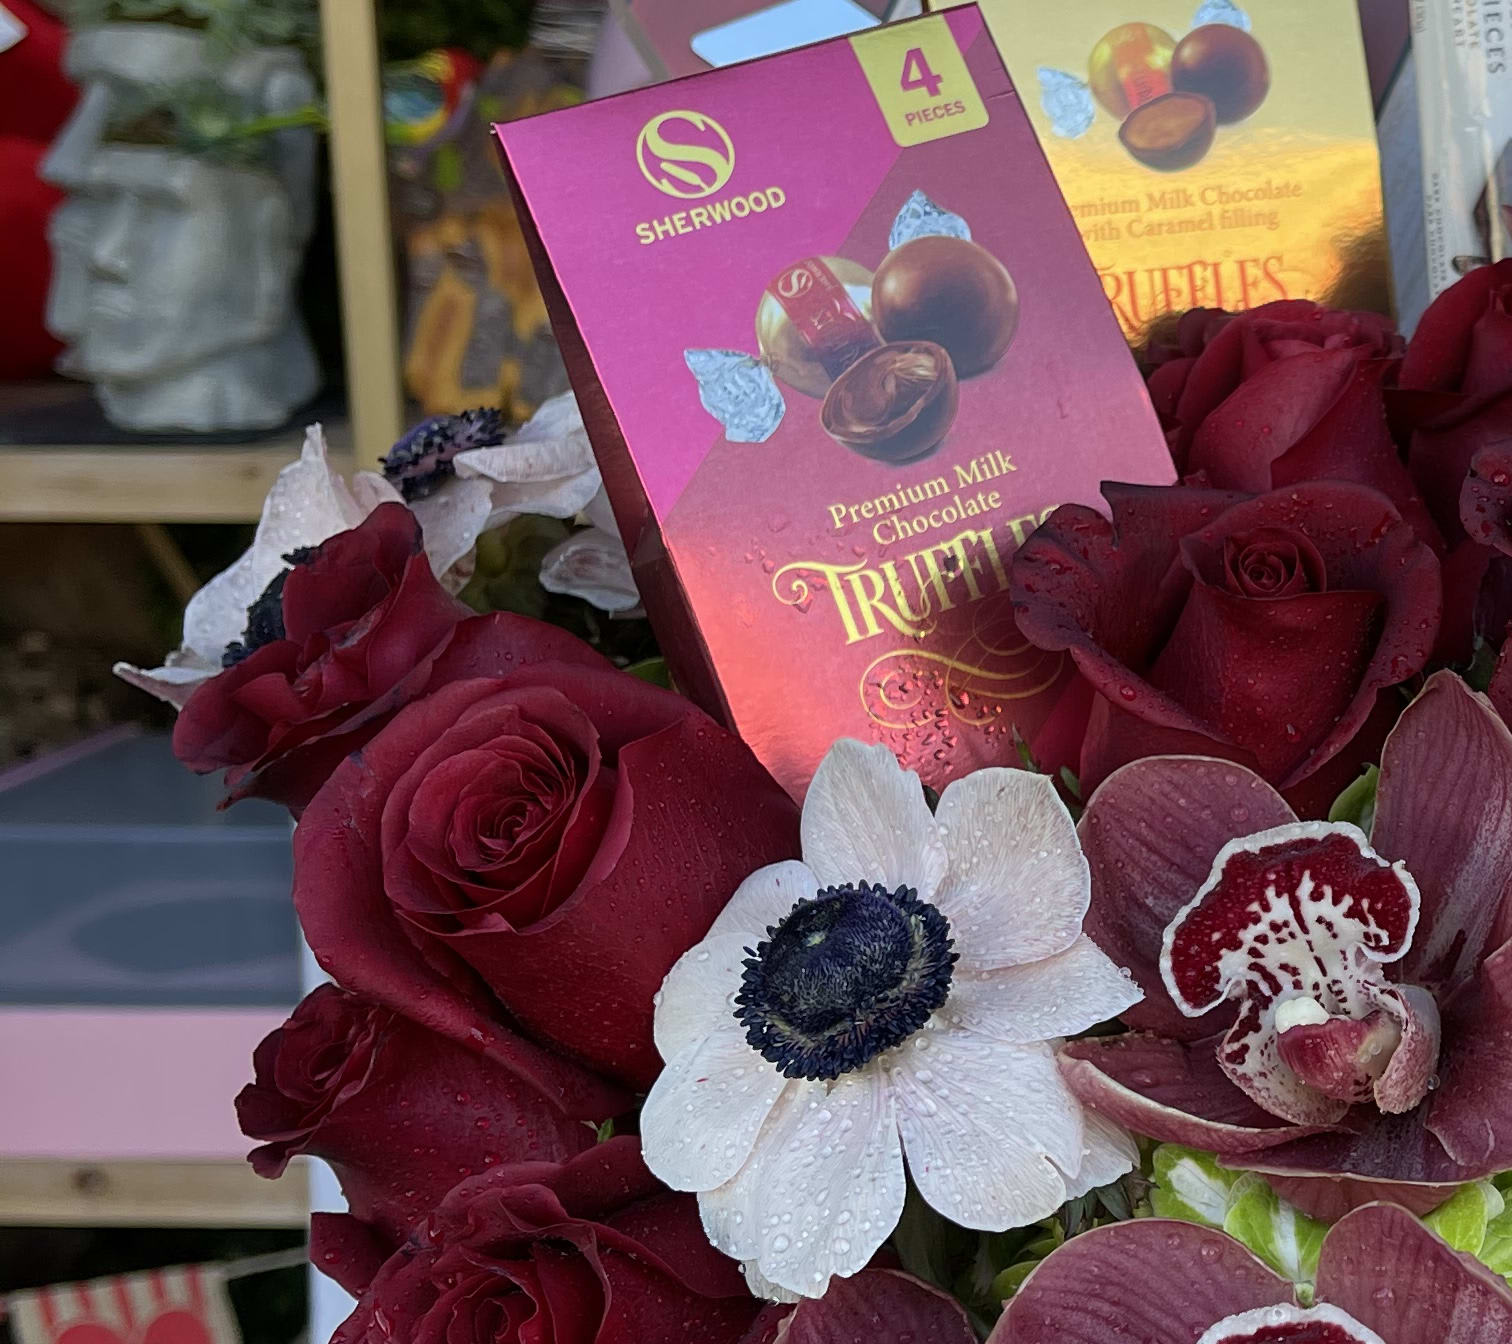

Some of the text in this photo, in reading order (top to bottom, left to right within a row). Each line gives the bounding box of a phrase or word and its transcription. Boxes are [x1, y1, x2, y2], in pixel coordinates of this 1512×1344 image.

[900, 47, 943, 97] 4
[904, 100, 967, 127] PIECES
[635, 186, 787, 246] SHERWOOD
[1146, 189, 1195, 212] Milk
[1200, 180, 1304, 207] Chocolate
[1126, 209, 1214, 239] Caramel
[1220, 208, 1281, 232] filling
[828, 449, 1018, 529] Premium Milk
[872, 489, 1003, 545] Chocolate
